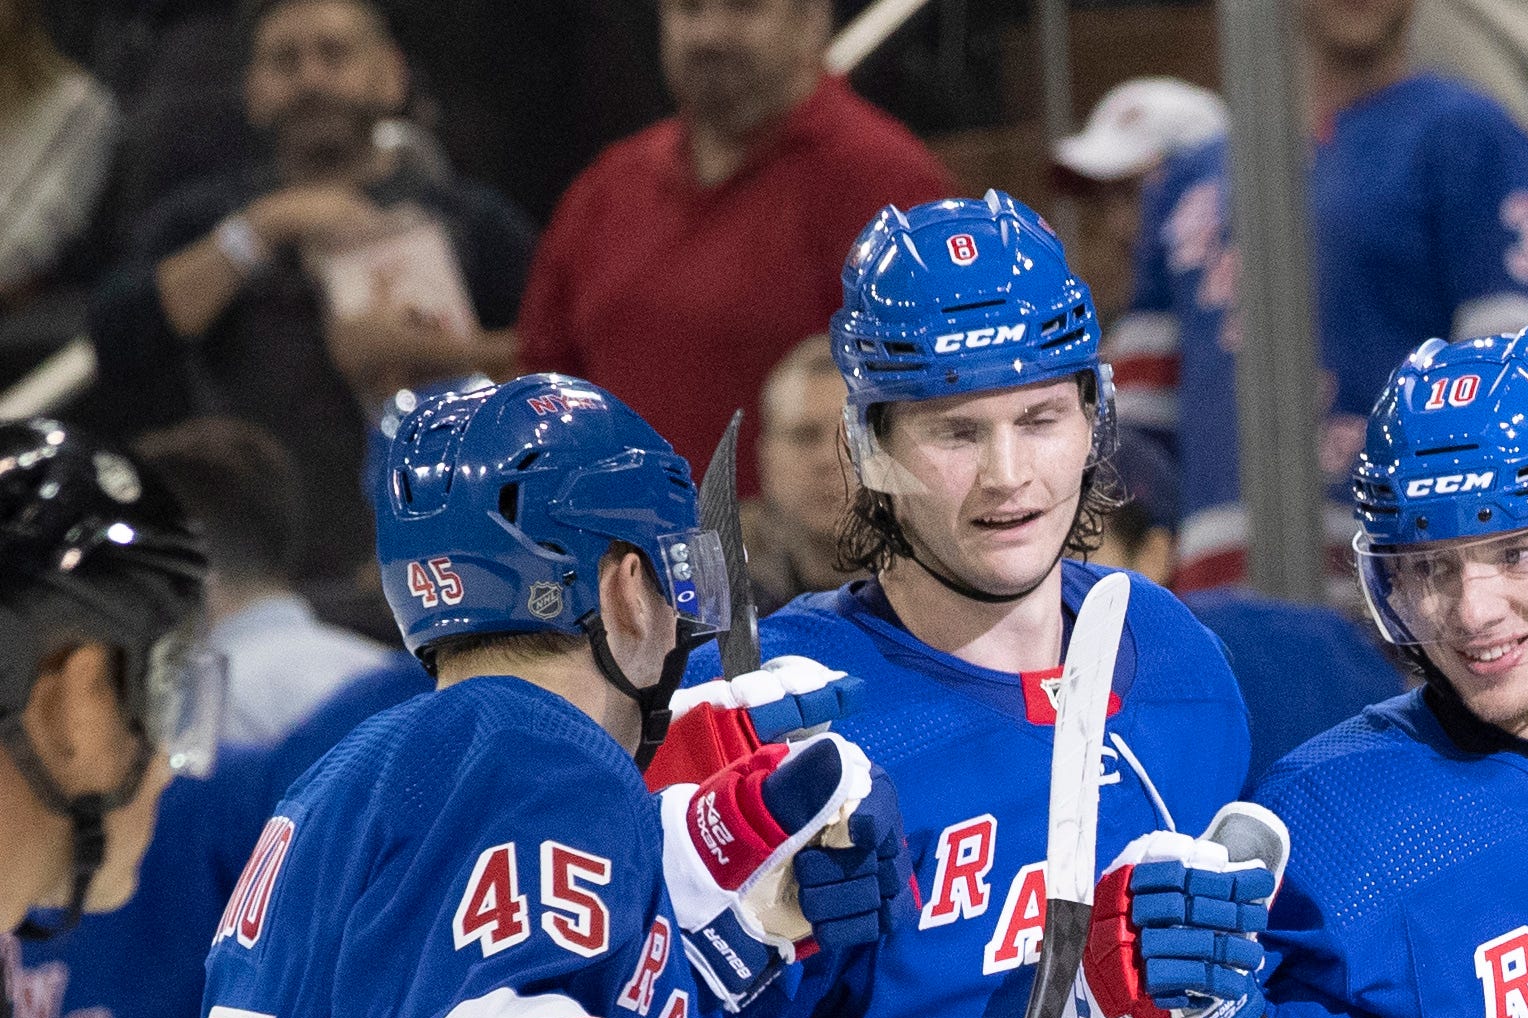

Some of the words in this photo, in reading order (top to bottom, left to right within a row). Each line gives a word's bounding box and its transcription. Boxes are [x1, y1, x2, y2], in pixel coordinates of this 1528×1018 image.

[946, 233, 979, 266] 8
[934, 323, 1027, 353] CCM
[1425, 374, 1481, 410] 10
[1406, 471, 1494, 497] CCM
[407, 556, 464, 608] 45
[452, 839, 612, 959] 45
